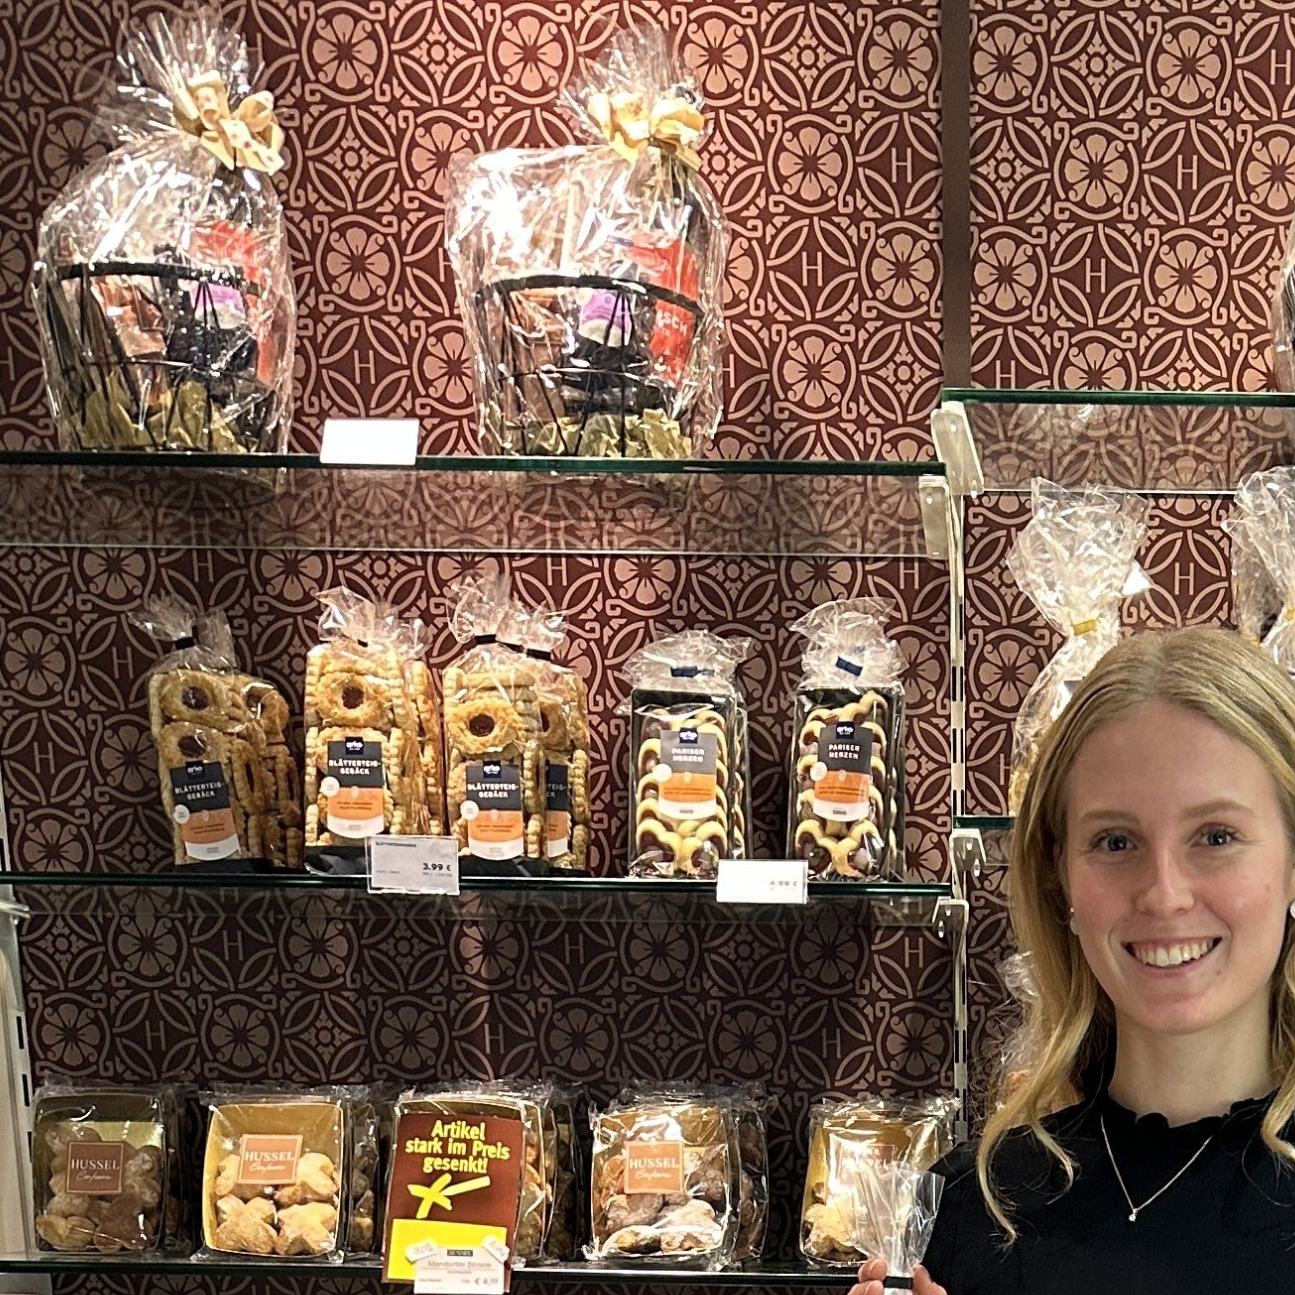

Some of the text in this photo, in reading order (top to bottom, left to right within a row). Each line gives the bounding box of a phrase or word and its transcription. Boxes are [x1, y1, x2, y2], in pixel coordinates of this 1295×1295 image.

[828, 744, 860, 752] PARISER
[423, 863, 443, 871] 3.99
[431, 1119, 486, 1141] Artikel
[405, 1138, 510, 1161] stark im Preis
[244, 1151, 295, 1162] HUSSEL
[71, 1158, 120, 1170] HUSSEL
[423, 1156, 488, 1174] gesenkt!
[630, 1158, 679, 1169] HUSSEL
